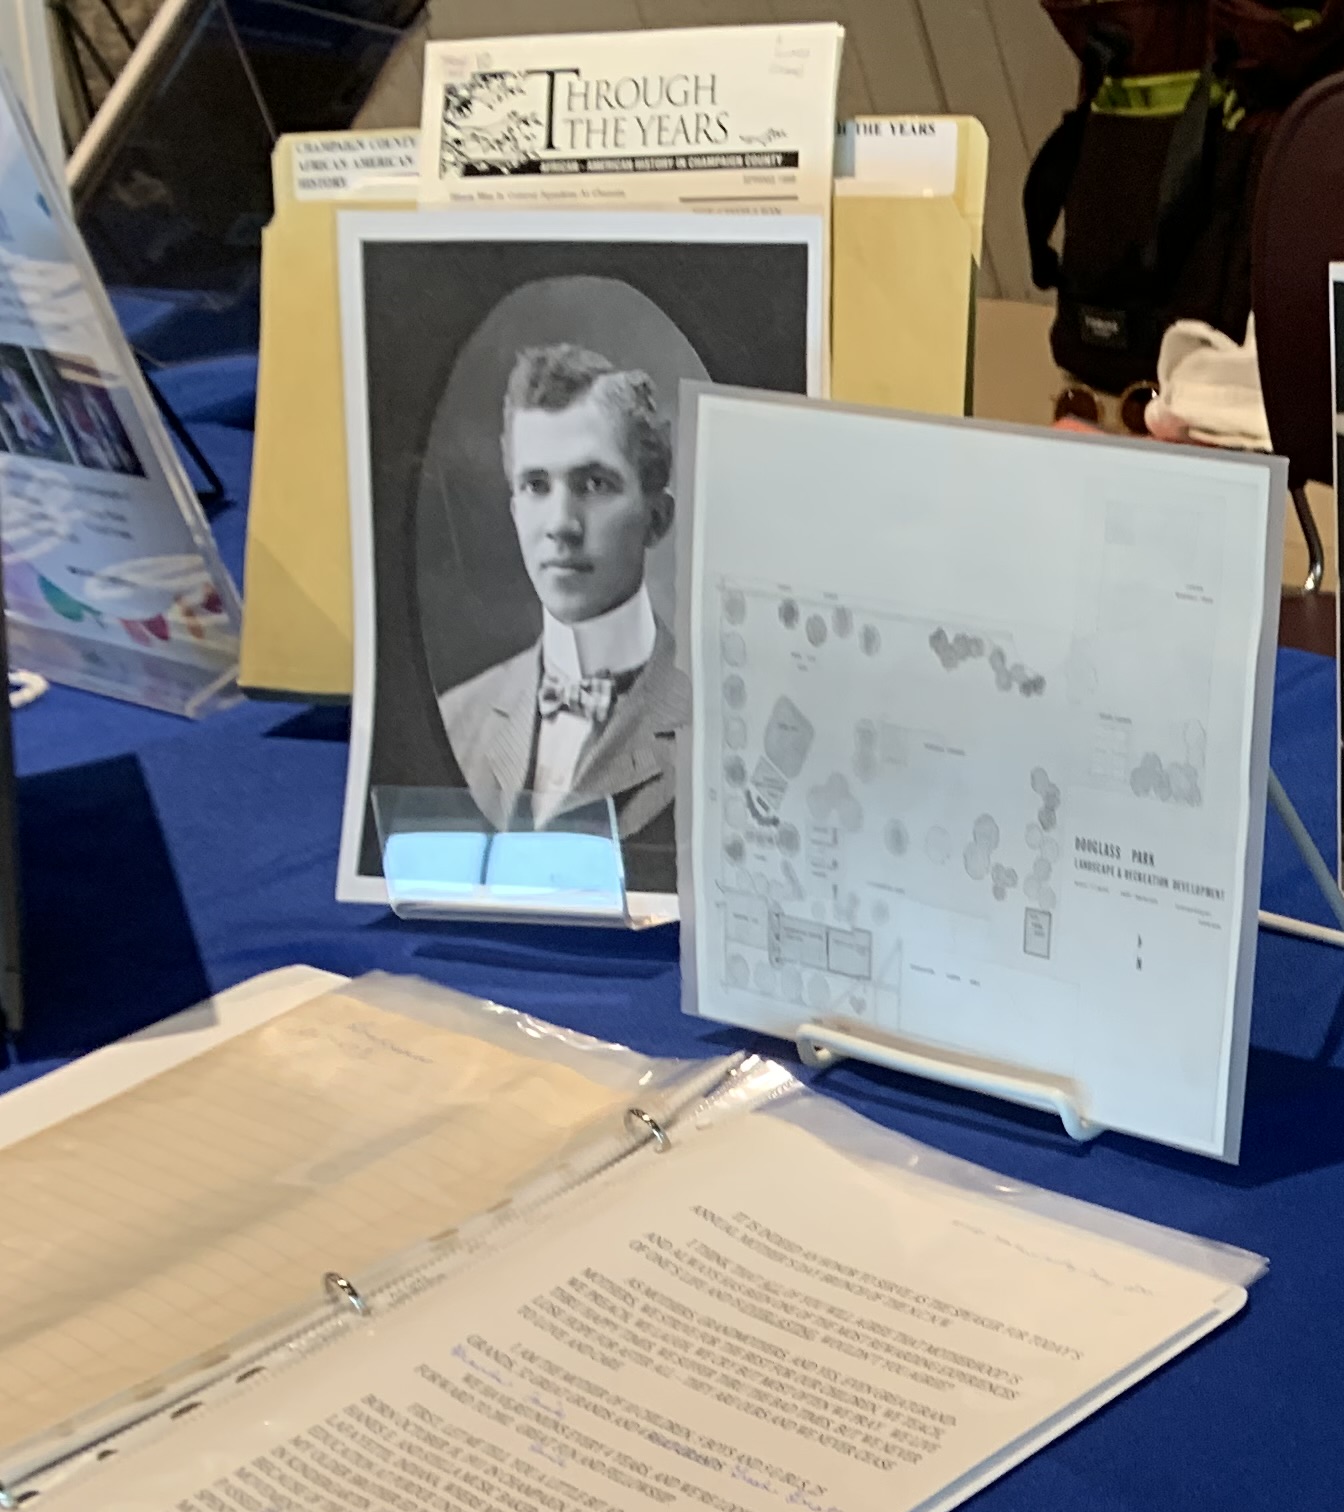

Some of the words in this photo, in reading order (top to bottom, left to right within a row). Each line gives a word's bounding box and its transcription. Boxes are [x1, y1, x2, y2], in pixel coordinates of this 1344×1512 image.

[525, 68, 717, 150] THROUGH
[564, 117, 627, 149] THE
[635, 111, 730, 146] YEARS
[890, 122, 936, 136] YEARS
[1074, 835, 1121, 859] DOUGLASS
[1131, 849, 1155, 866] PARK
